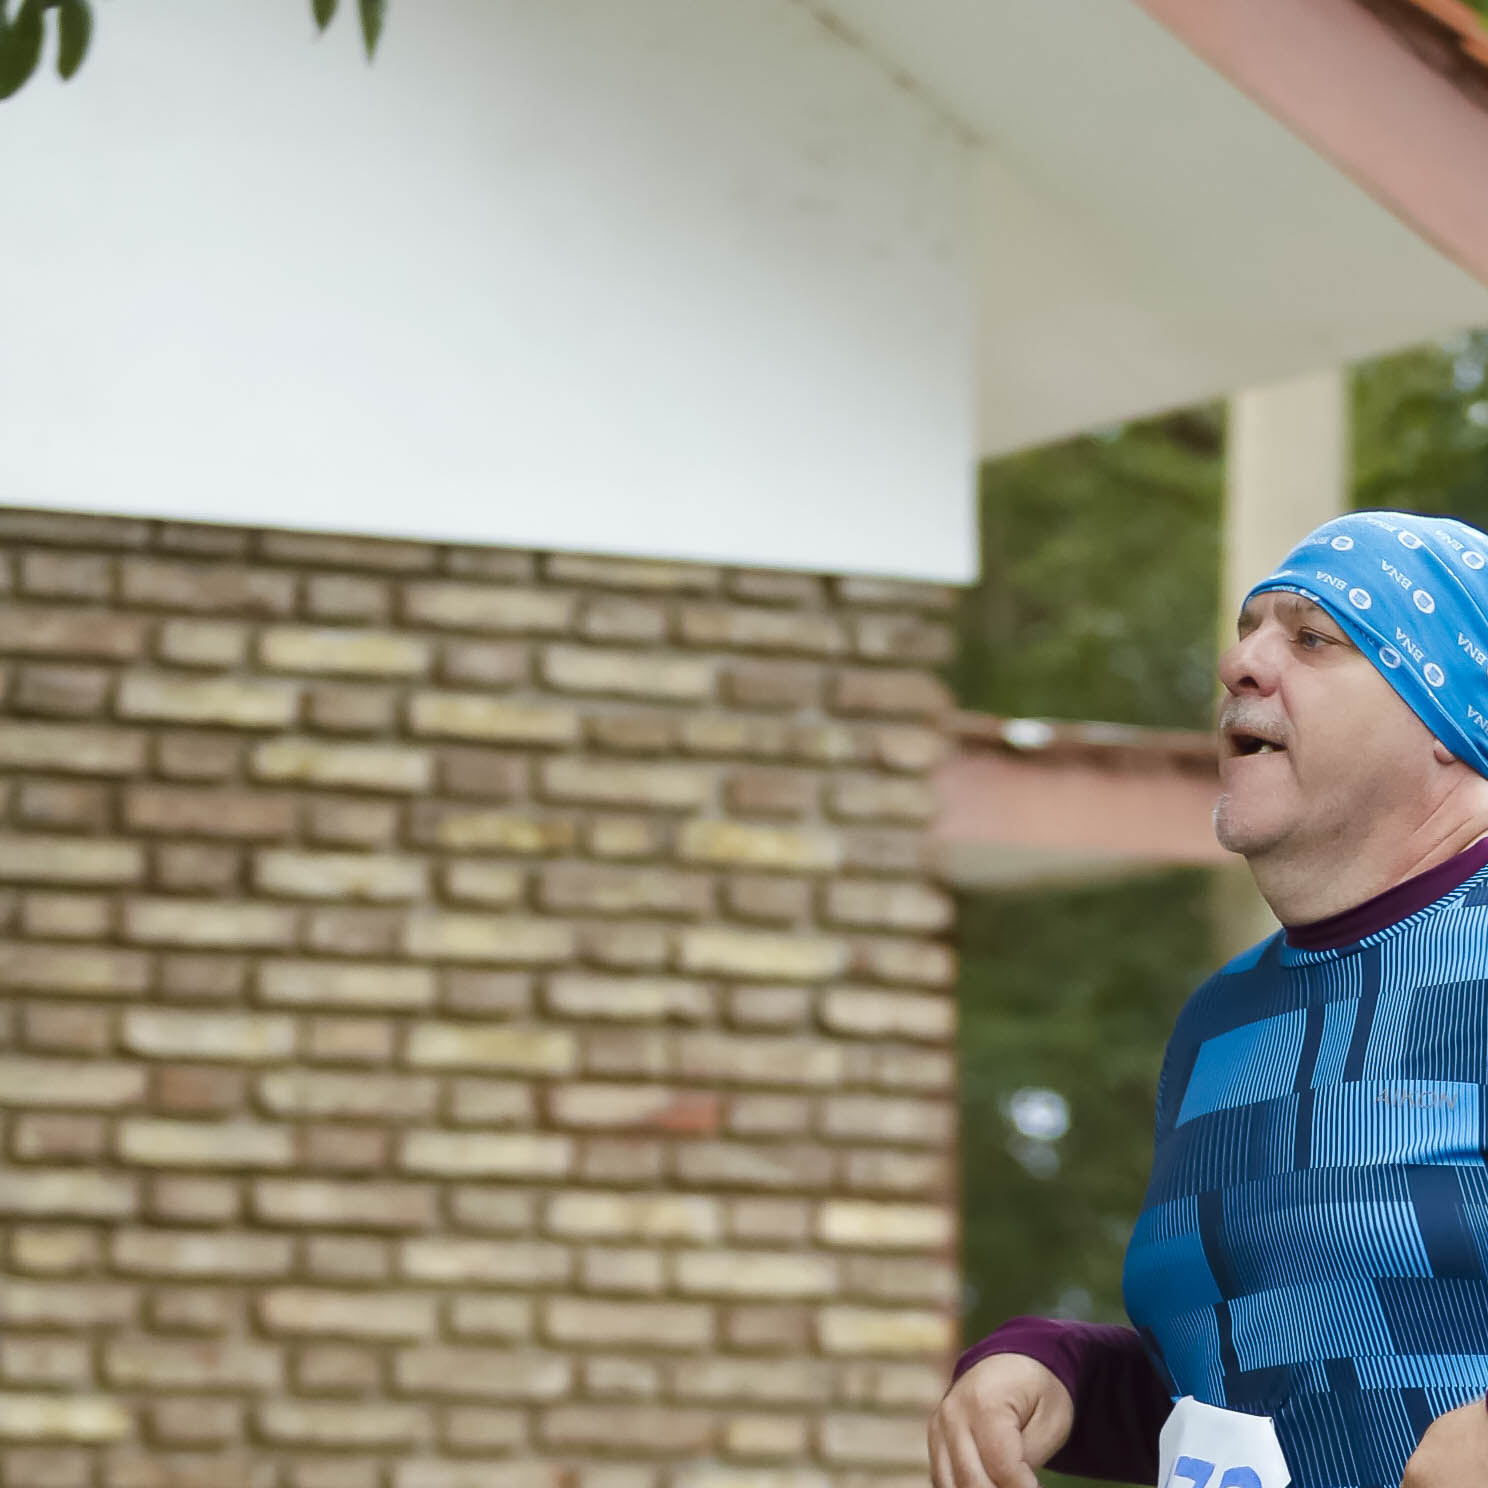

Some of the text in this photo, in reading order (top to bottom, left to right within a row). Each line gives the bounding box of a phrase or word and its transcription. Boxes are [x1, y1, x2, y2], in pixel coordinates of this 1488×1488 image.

[1316, 570, 1348, 591] BNA
[1382, 559, 1412, 590] BNA
[1395, 627, 1425, 663] BNA
[1457, 632, 1487, 665] BNA
